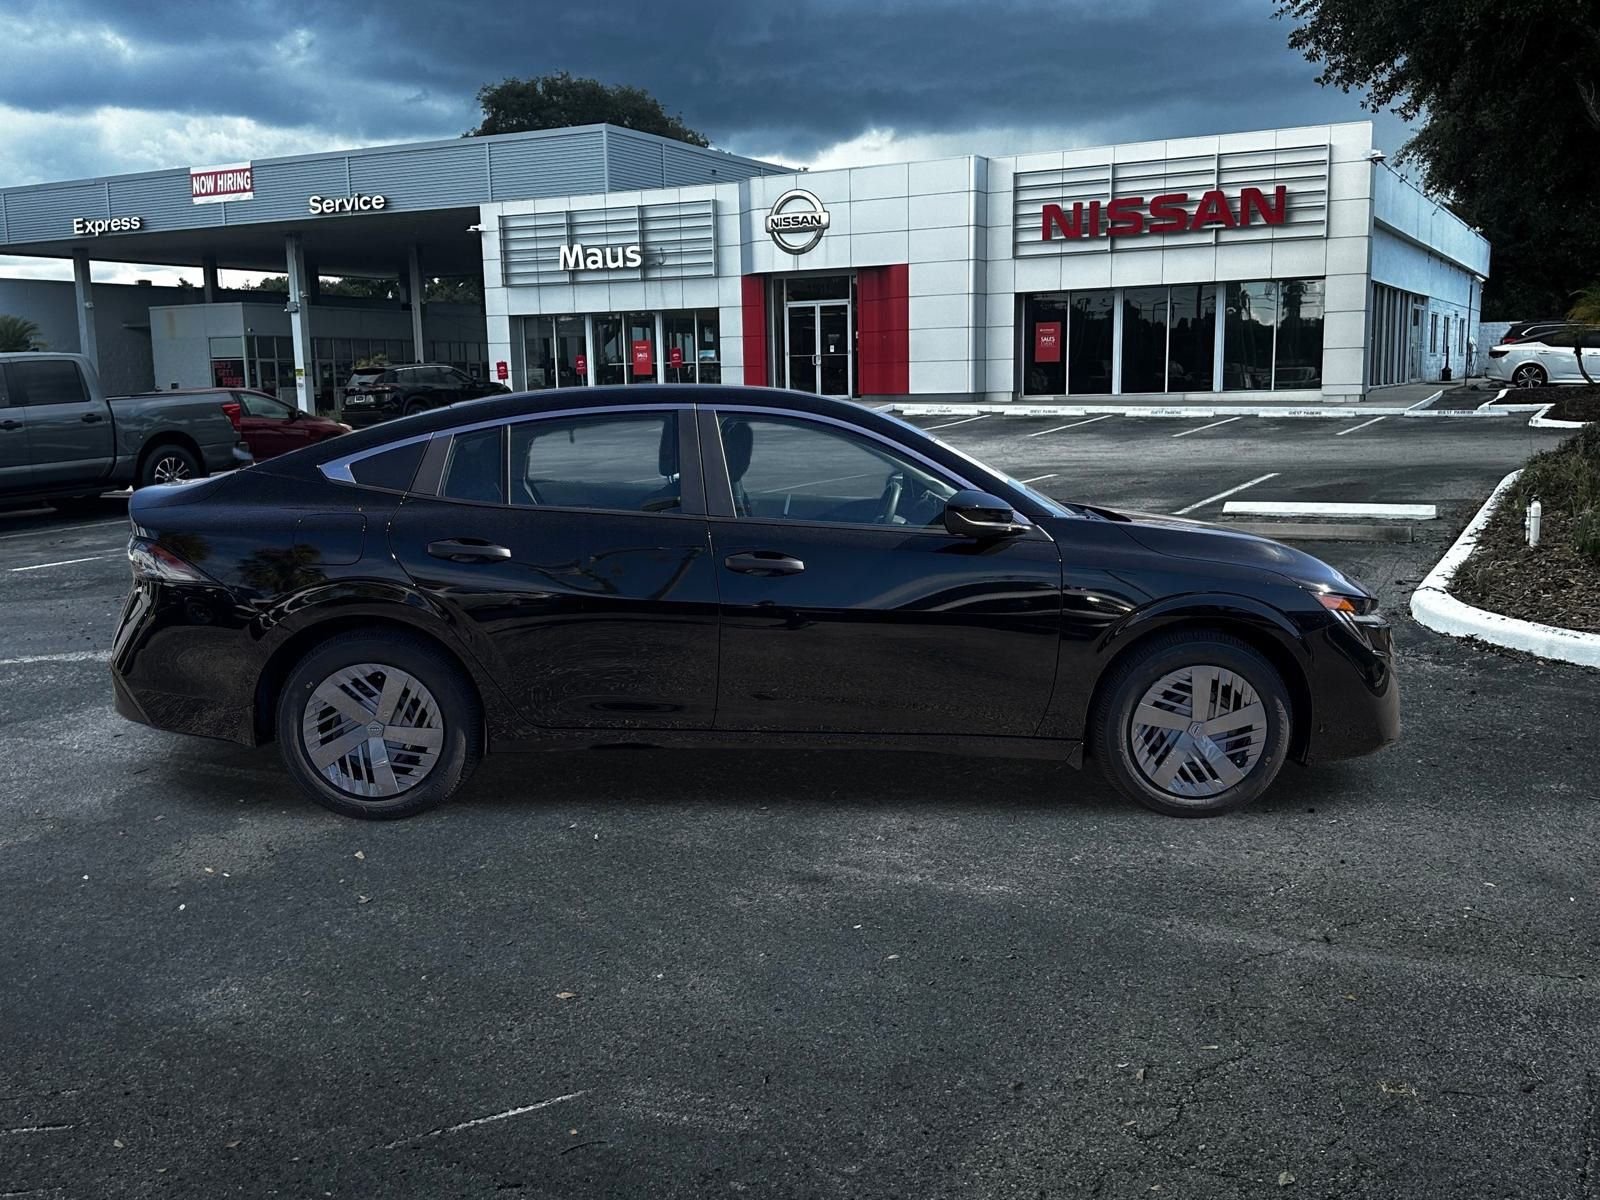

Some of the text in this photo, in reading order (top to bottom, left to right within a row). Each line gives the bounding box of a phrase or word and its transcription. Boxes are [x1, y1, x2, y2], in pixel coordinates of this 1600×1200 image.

[192, 171, 250, 194] NOW HIRING
[309, 193, 385, 214] Service
[1041, 185, 1287, 241] NISSAN
[73, 217, 141, 236] Express
[770, 215, 821, 228] NISSAN
[559, 244, 641, 271] Maus
[222, 376, 244, 386] FREE
